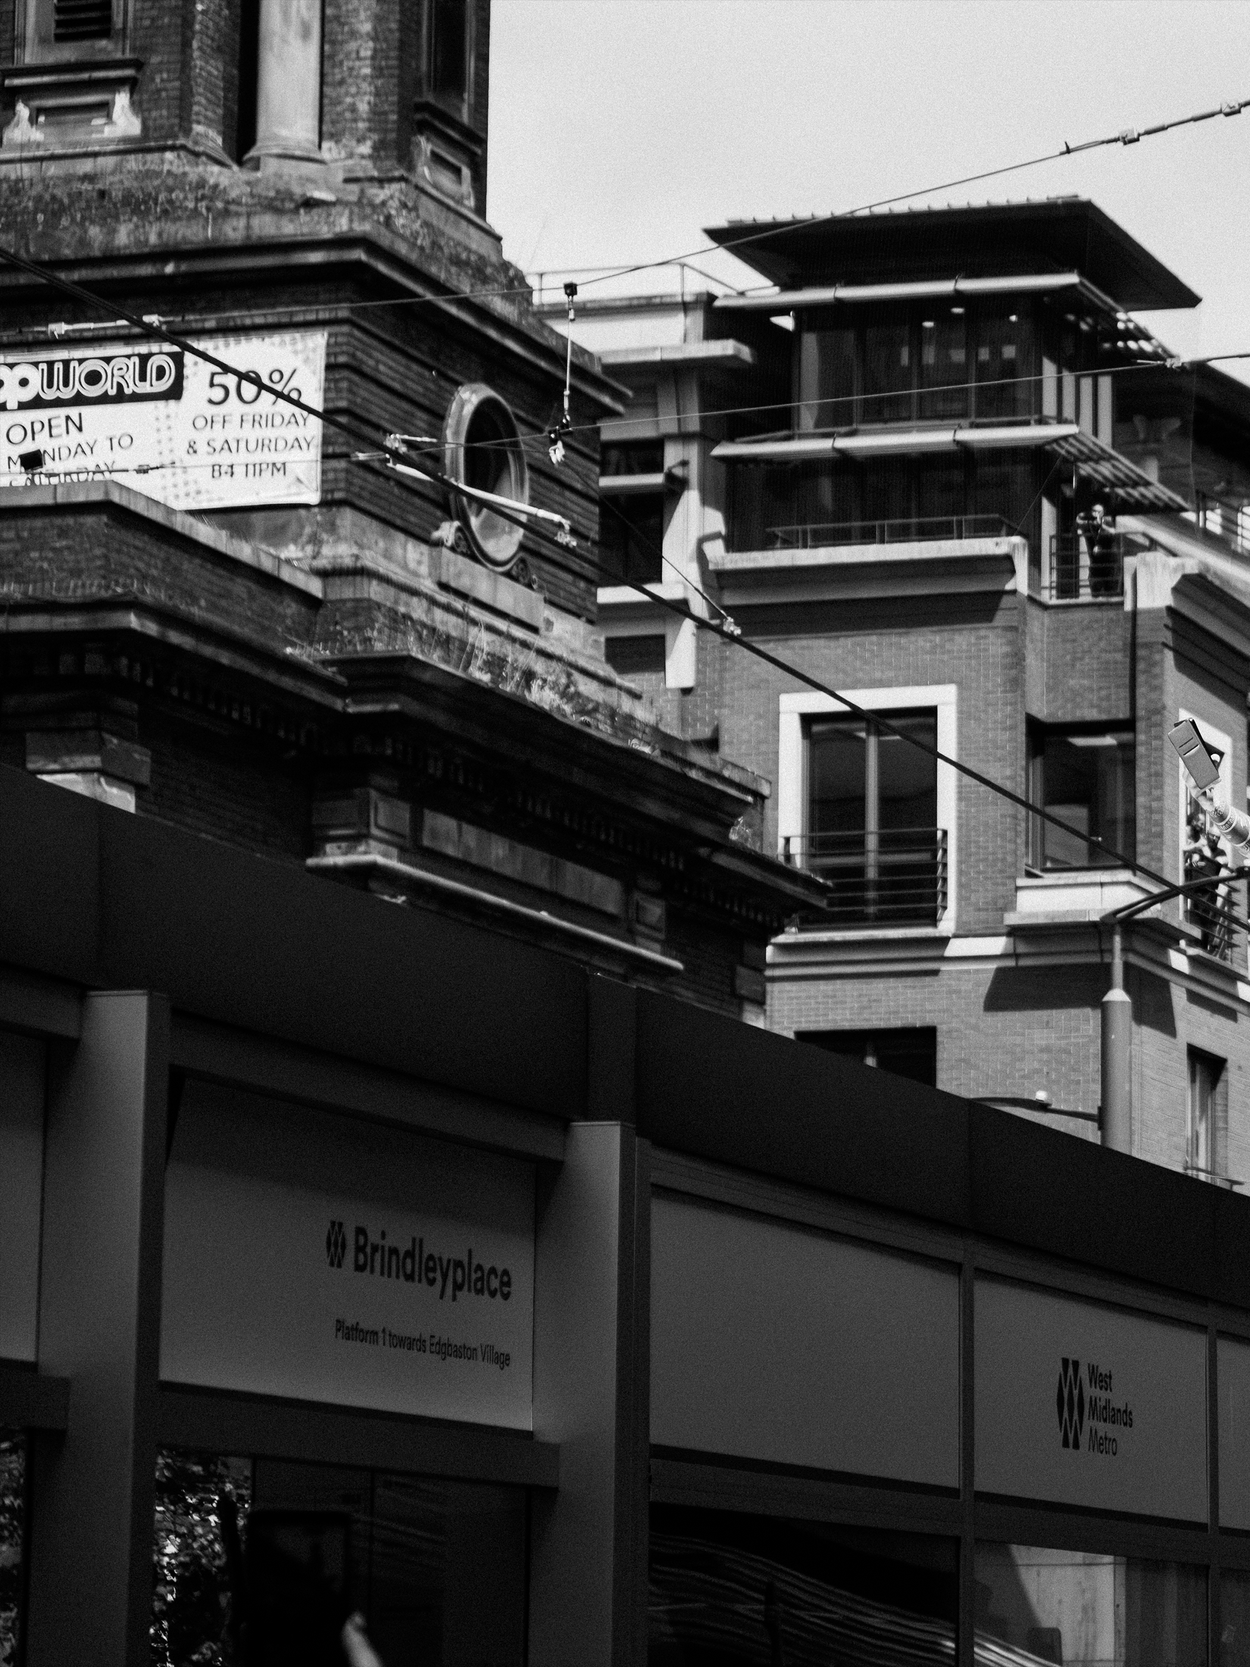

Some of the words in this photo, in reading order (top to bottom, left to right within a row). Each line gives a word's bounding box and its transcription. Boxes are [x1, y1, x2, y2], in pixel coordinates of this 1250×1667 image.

[207, 367, 302, 406] 50%
[6, 412, 84, 445] OPEN
[192, 412, 232, 431] OFF
[239, 411, 310, 429] FRIDAY
[7, 438, 98, 471] MNDAY
[106, 433, 134, 452] TO
[186, 440, 198, 454] &
[206, 436, 315, 455] SATURDAY
[353, 1225, 512, 1302] Brindleyplace
[334, 1318, 379, 1346] Platform
[381, 1327, 387, 1347] 1
[389, 1332, 427, 1354] towards
[429, 1334, 478, 1361] Edgbaston
[479, 1343, 511, 1371] Village
[1087, 1362, 1113, 1393] West
[1087, 1395, 1134, 1429] Midlands
[1087, 1425, 1118, 1457] Metro
